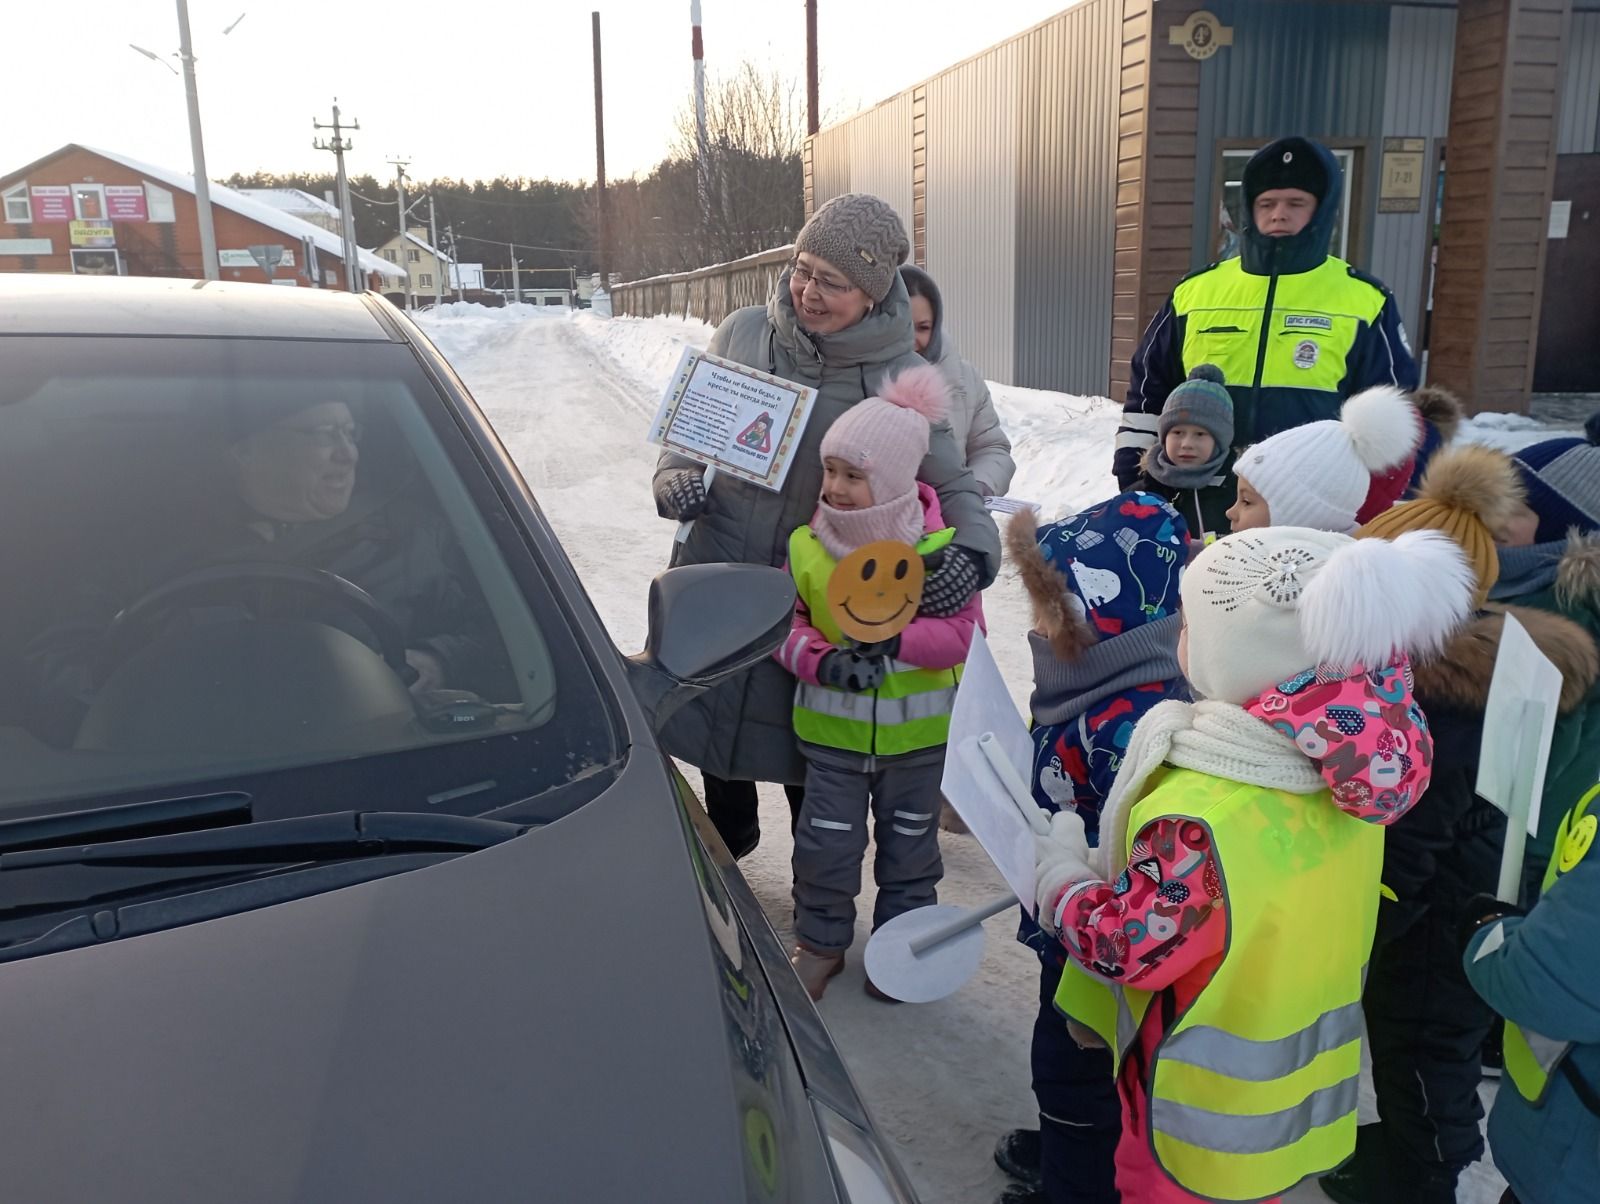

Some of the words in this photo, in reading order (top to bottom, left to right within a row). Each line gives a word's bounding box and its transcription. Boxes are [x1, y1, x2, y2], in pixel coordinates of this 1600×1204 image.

[711, 371, 732, 384] Чтобы
[708, 381, 730, 393] кресле
[730, 388, 739, 396] ты
[740, 392, 760, 404] всегда
[761, 400, 778, 410] вези!
